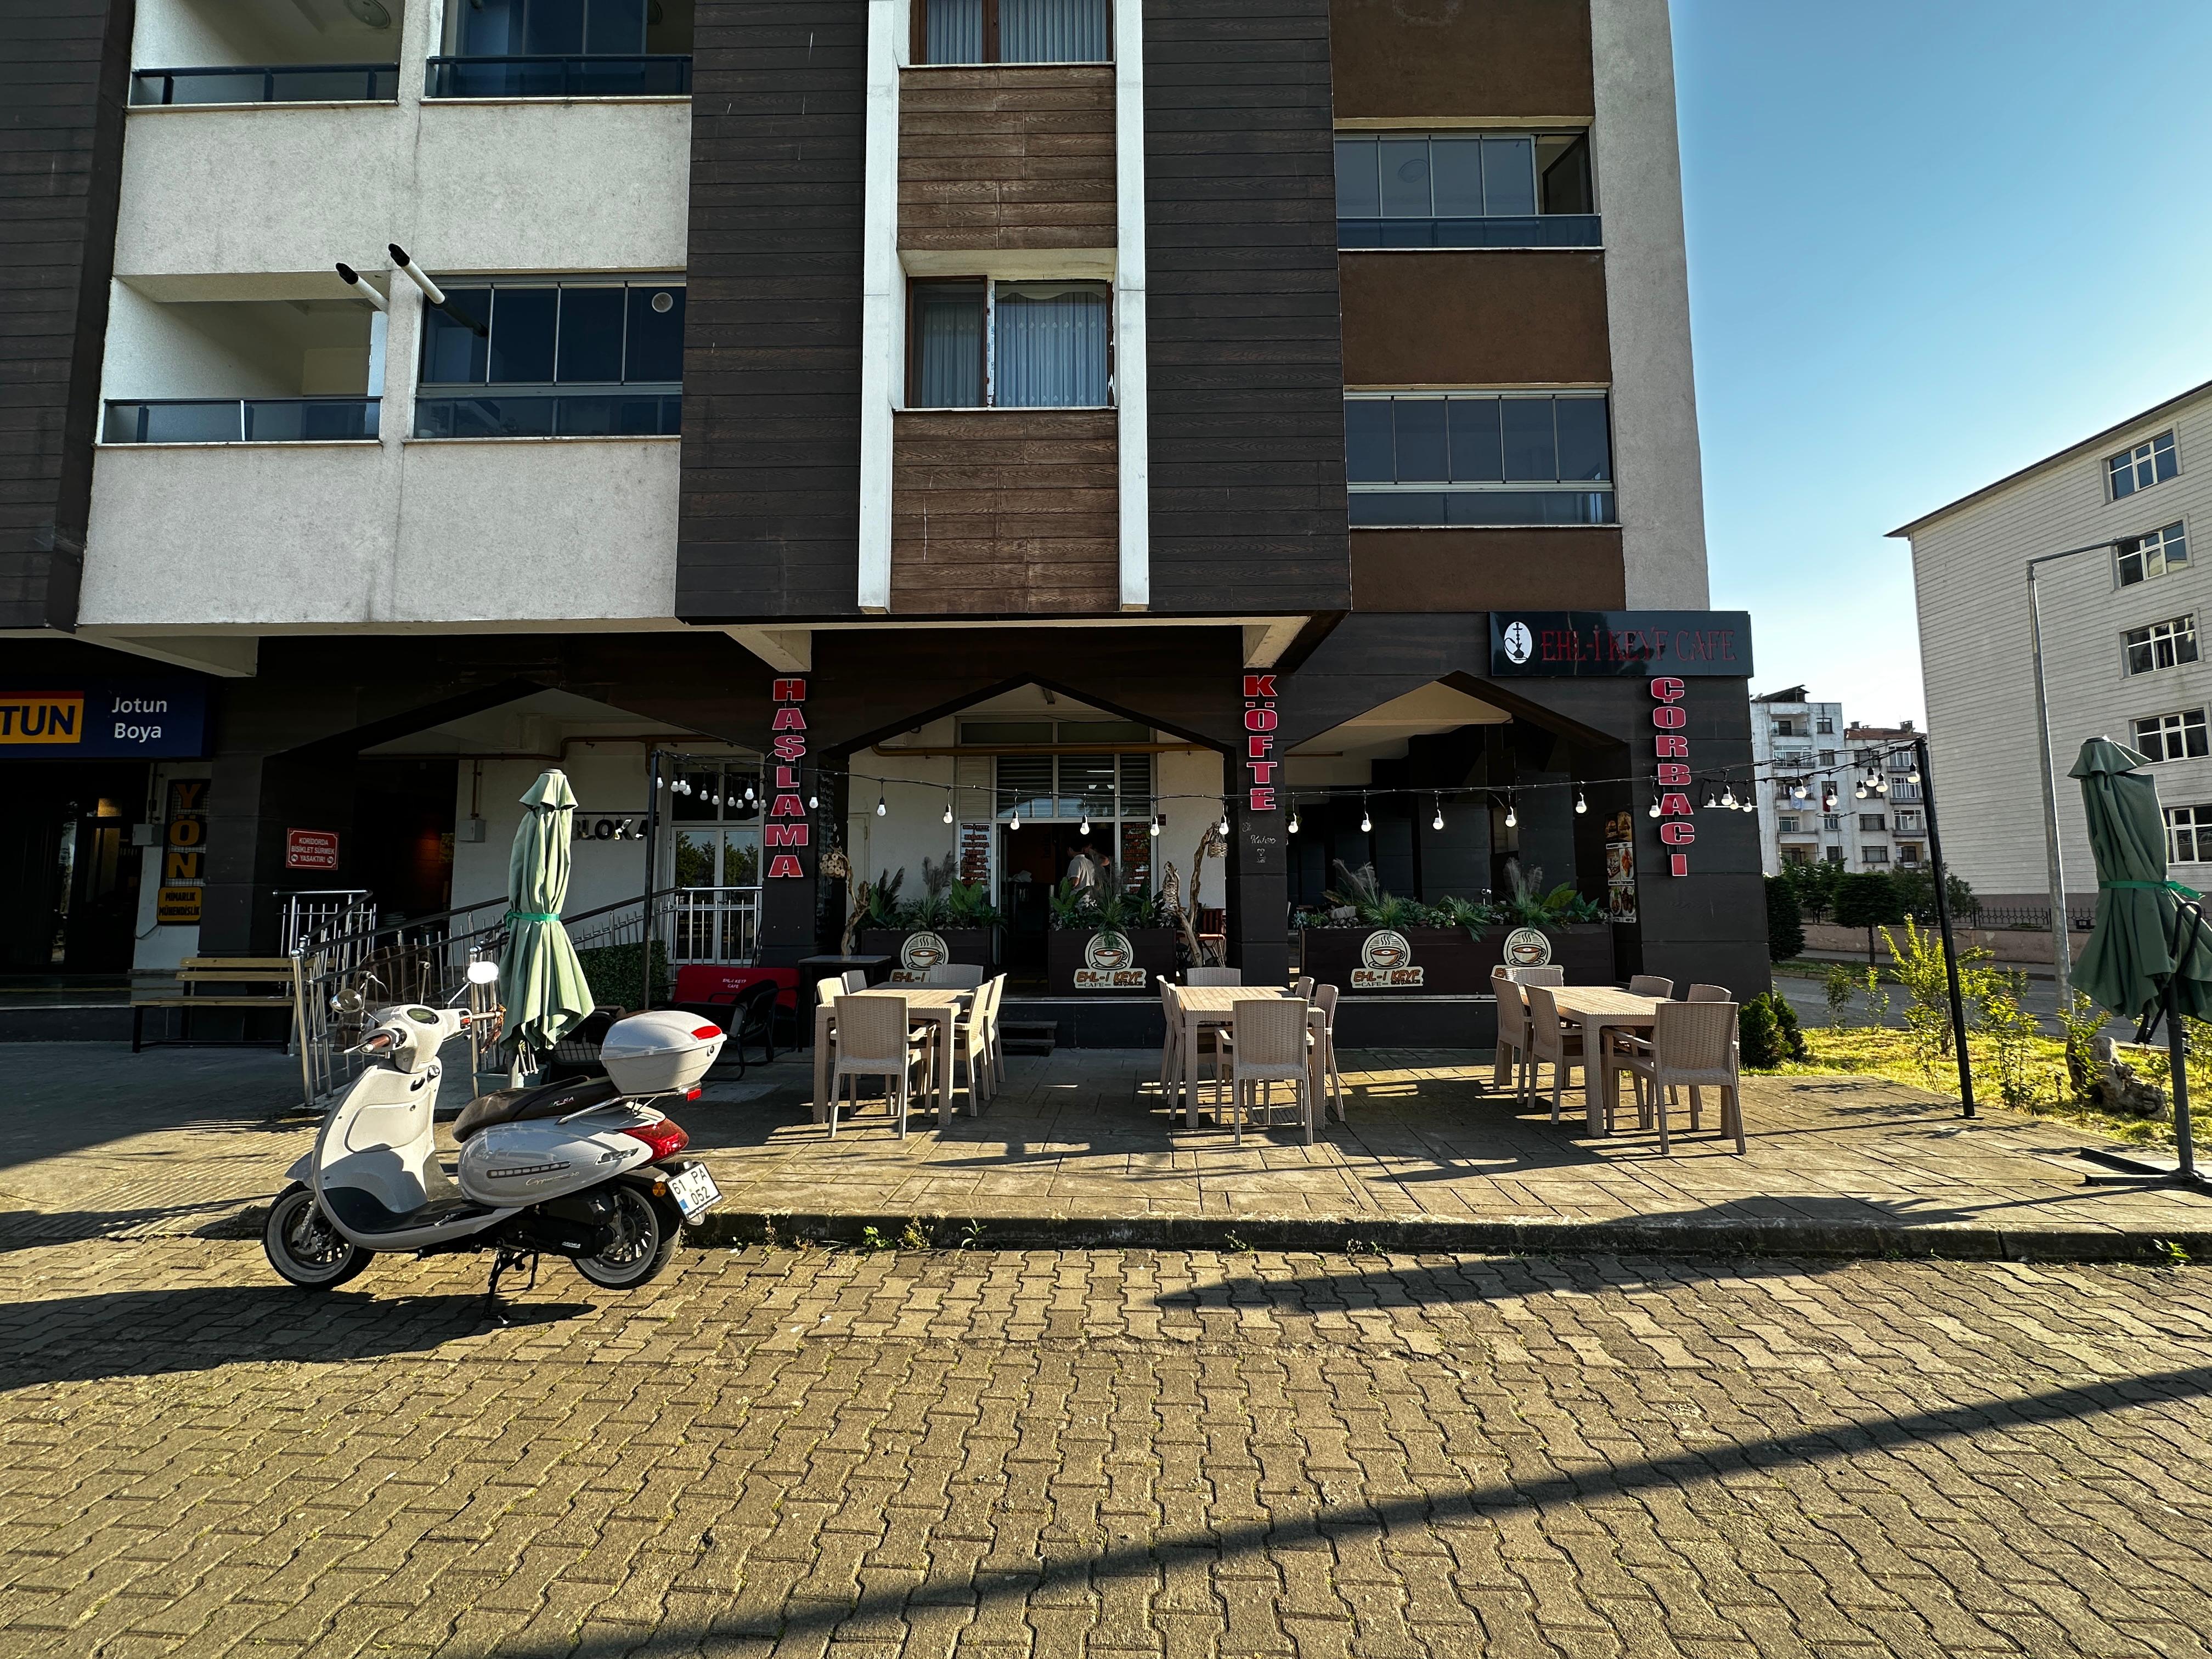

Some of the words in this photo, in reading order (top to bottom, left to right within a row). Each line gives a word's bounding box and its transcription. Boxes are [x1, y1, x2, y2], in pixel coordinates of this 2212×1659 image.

[1608, 629, 1669, 662] KEYF
[1675, 630, 1736, 662] CAFE
[111, 697, 167, 713] Jotun
[114, 722, 162, 743] Boya
[1244, 675, 1278, 810] KÖFTE
[765, 678, 809, 878] HAŞLAMA
[1651, 678, 1694, 877] ÇORBACI
[167, 783, 202, 878] YÖN
[291, 845, 314, 854] BİSİKLET
[314, 845, 335, 855] SÜRMEK
[298, 837, 329, 845] KORİDORDA
[165, 890, 196, 901] MİMARLIK
[159, 904, 200, 916] MÜHENDİSLİK
[1113, 970, 1143, 983] KEYF
[1391, 969, 1421, 981] KEYF
[672, 1179, 686, 1195] 61
[690, 1167, 707, 1184] PA
[690, 1186, 710, 1205] 052
